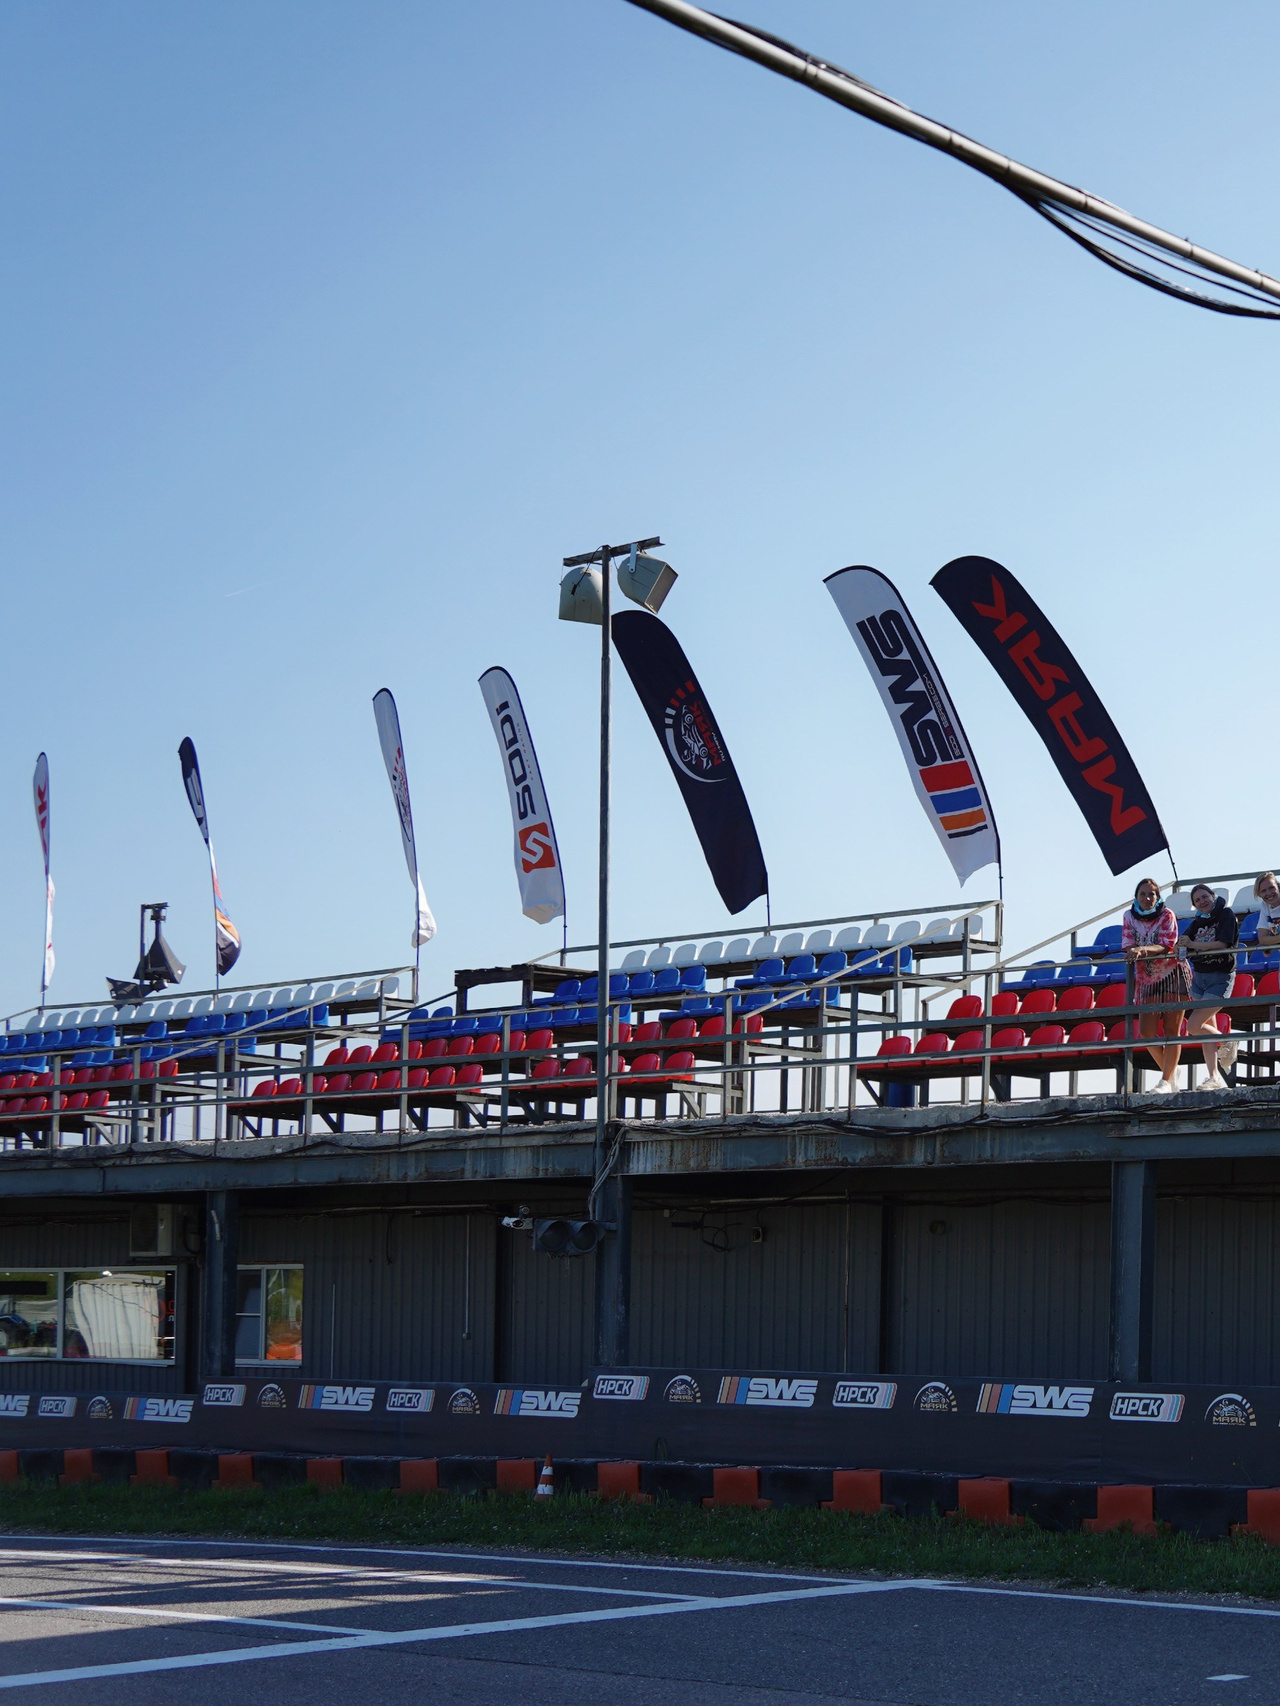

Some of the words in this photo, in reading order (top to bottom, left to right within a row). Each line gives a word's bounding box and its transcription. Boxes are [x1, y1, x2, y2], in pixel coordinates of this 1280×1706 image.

[856, 609, 965, 767] SWS
[971, 573, 1148, 837] МАЯК
[0, 1395, 30, 1417] WS
[320, 1386, 376, 1412] SWS
[518, 1390, 582, 1418] SWS
[745, 1378, 818, 1408] SWS
[1009, 1385, 1095, 1417] SWS
[143, 1398, 194, 1423] SWS
